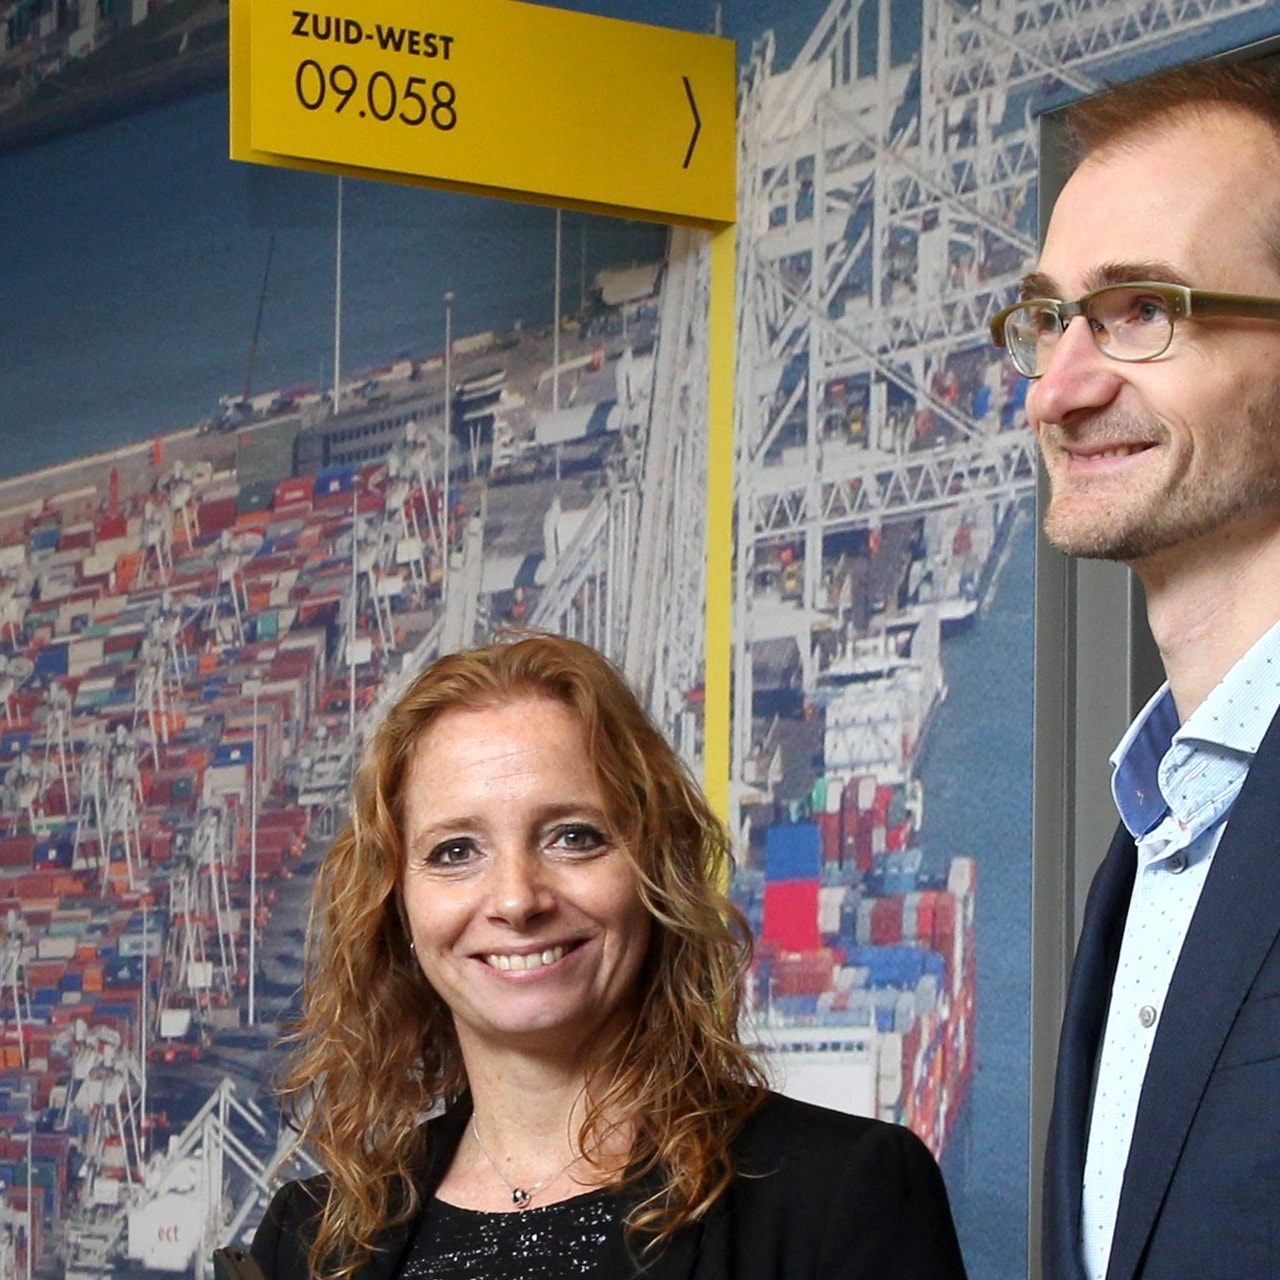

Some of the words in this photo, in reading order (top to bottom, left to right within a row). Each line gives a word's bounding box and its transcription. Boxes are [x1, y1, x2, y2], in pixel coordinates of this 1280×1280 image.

[292, 11, 454, 60] ZUID-WEST
[295, 59, 457, 131] 09.058
[158, 1224, 179, 1242] ect
